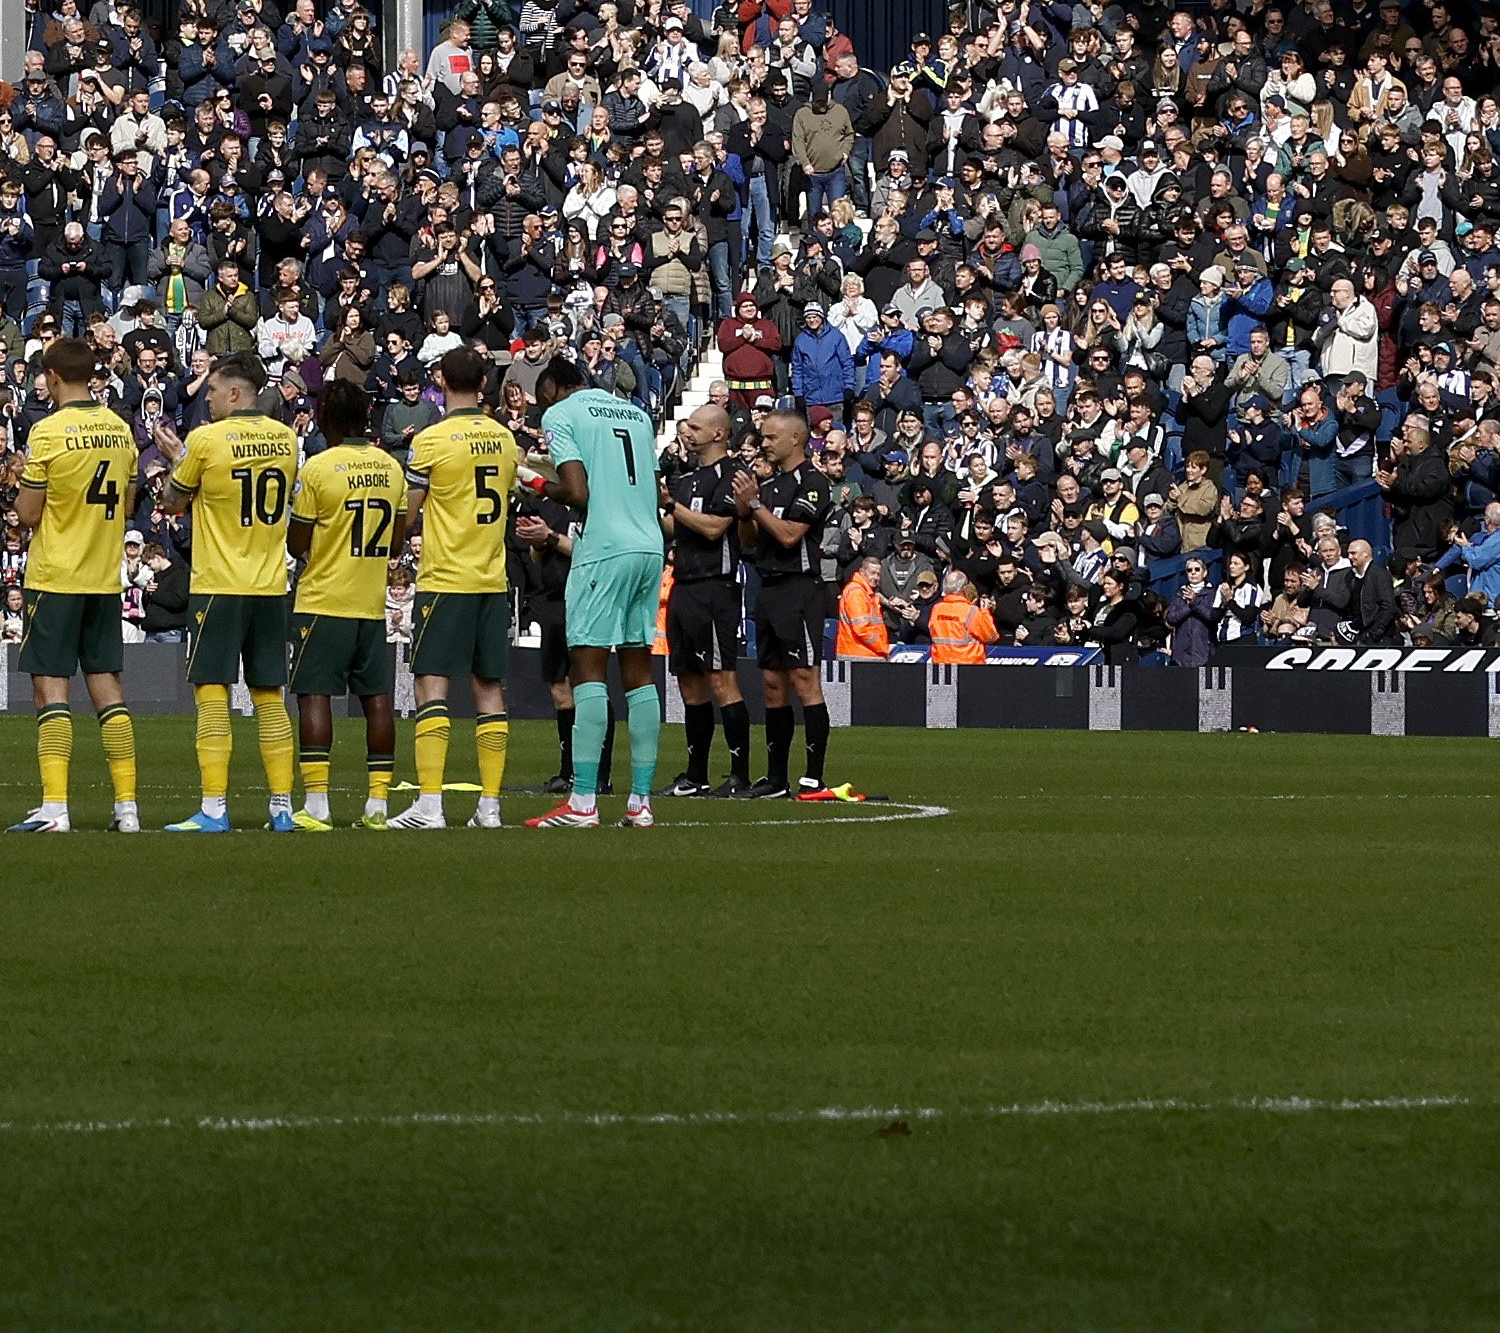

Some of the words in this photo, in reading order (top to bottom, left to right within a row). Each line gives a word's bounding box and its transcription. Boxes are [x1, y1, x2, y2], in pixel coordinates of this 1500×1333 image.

[588, 406, 644, 422] OKONKWO
[79, 423, 105, 433] Meta
[240, 431, 266, 441] Meta
[464, 431, 489, 440] Meta
[65, 434, 130, 451] CLEWORTH
[231, 443, 291, 458] WINDASS
[470, 441, 503, 455] HYAM
[612, 428, 637, 486] 1
[348, 462, 373, 471] Meta
[374, 460, 393, 471] Quest
[347, 471, 391, 490] KABORÉ
[86, 460, 120, 520] 4
[231, 467, 287, 527] 10
[475, 465, 502, 525] 5
[344, 498, 392, 557] 12
